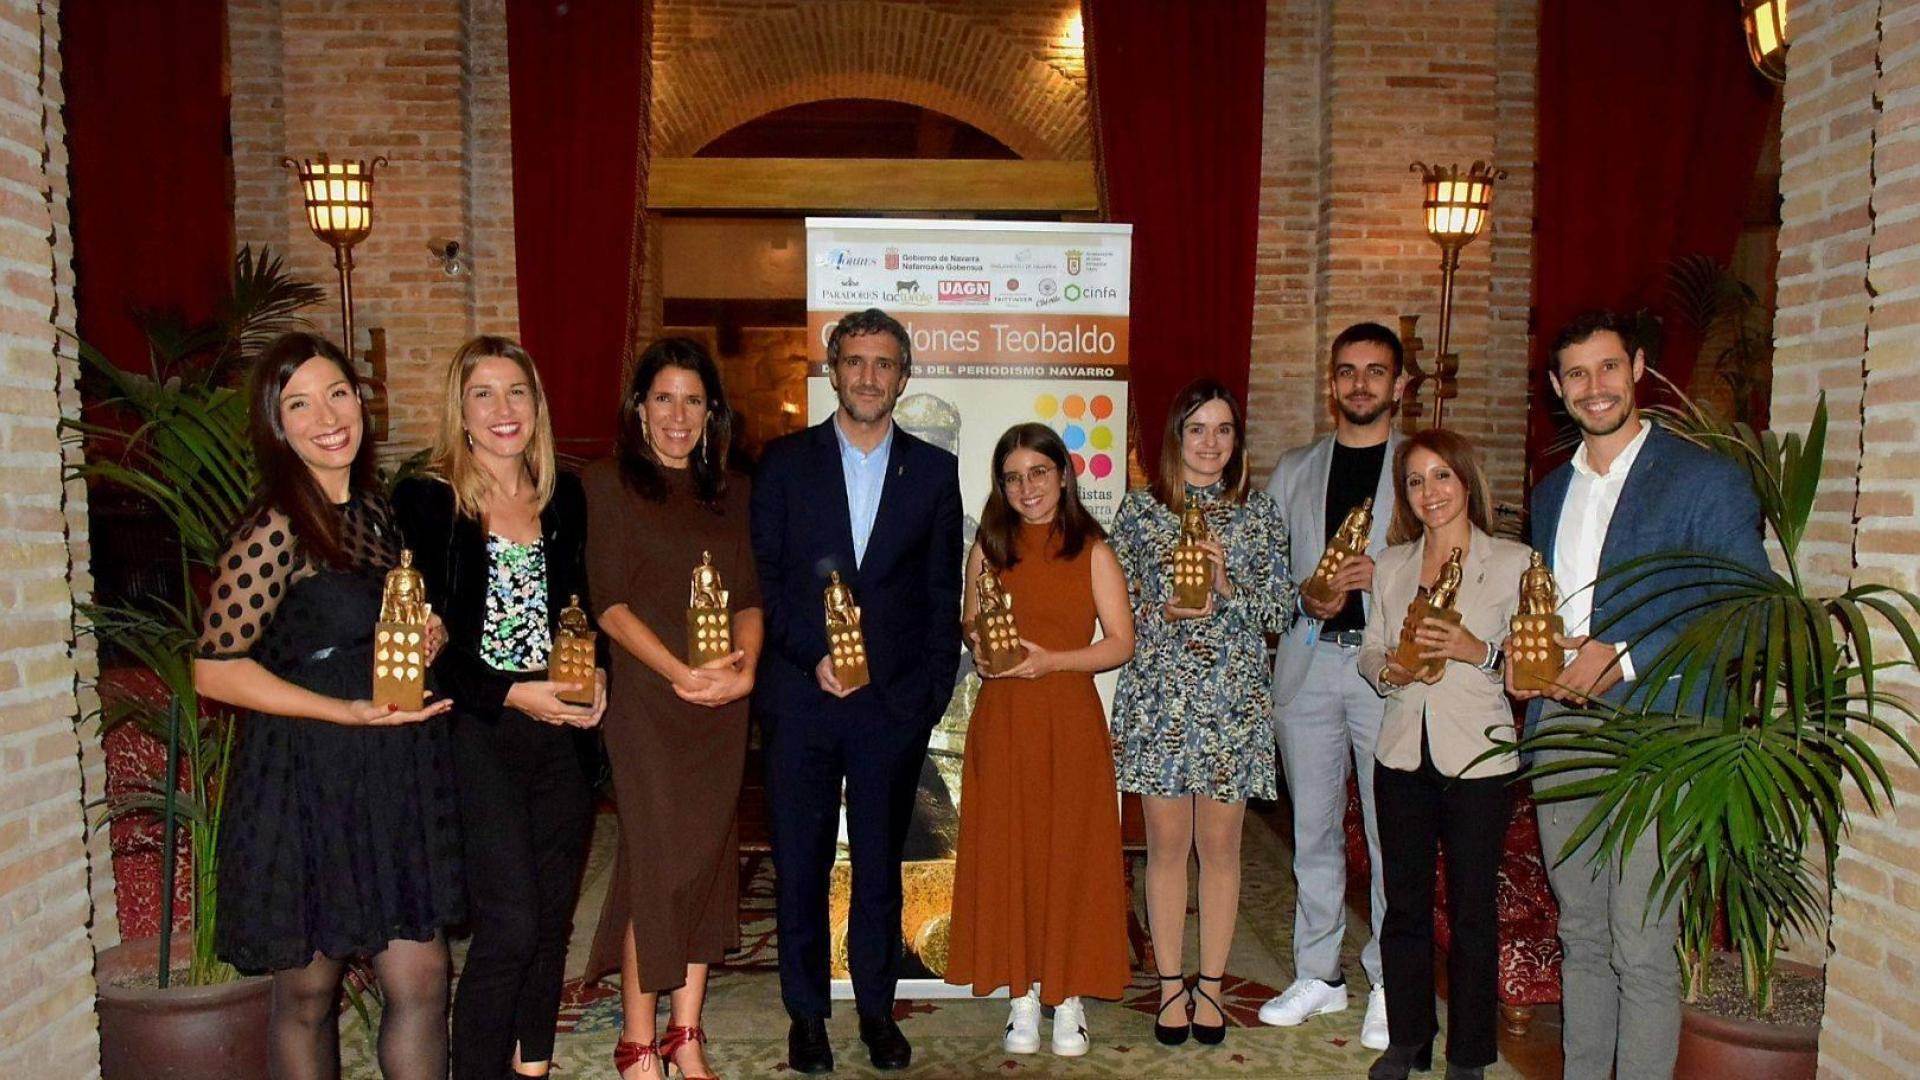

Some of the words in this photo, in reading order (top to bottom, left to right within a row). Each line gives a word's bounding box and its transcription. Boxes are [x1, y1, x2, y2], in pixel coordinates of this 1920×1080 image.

[902, 254, 938, 262] Gobierno
[938, 254, 950, 262] de
[902, 263, 945, 271] Nafarroako
[939, 281, 989, 295] UAGN
[822, 289, 879, 300] PARADORES
[989, 323, 1116, 354] Teobaldo
[927, 365, 953, 374] DEL
[957, 365, 1045, 376] PERIODISMO
[1049, 366, 1115, 377] NAVARRO
